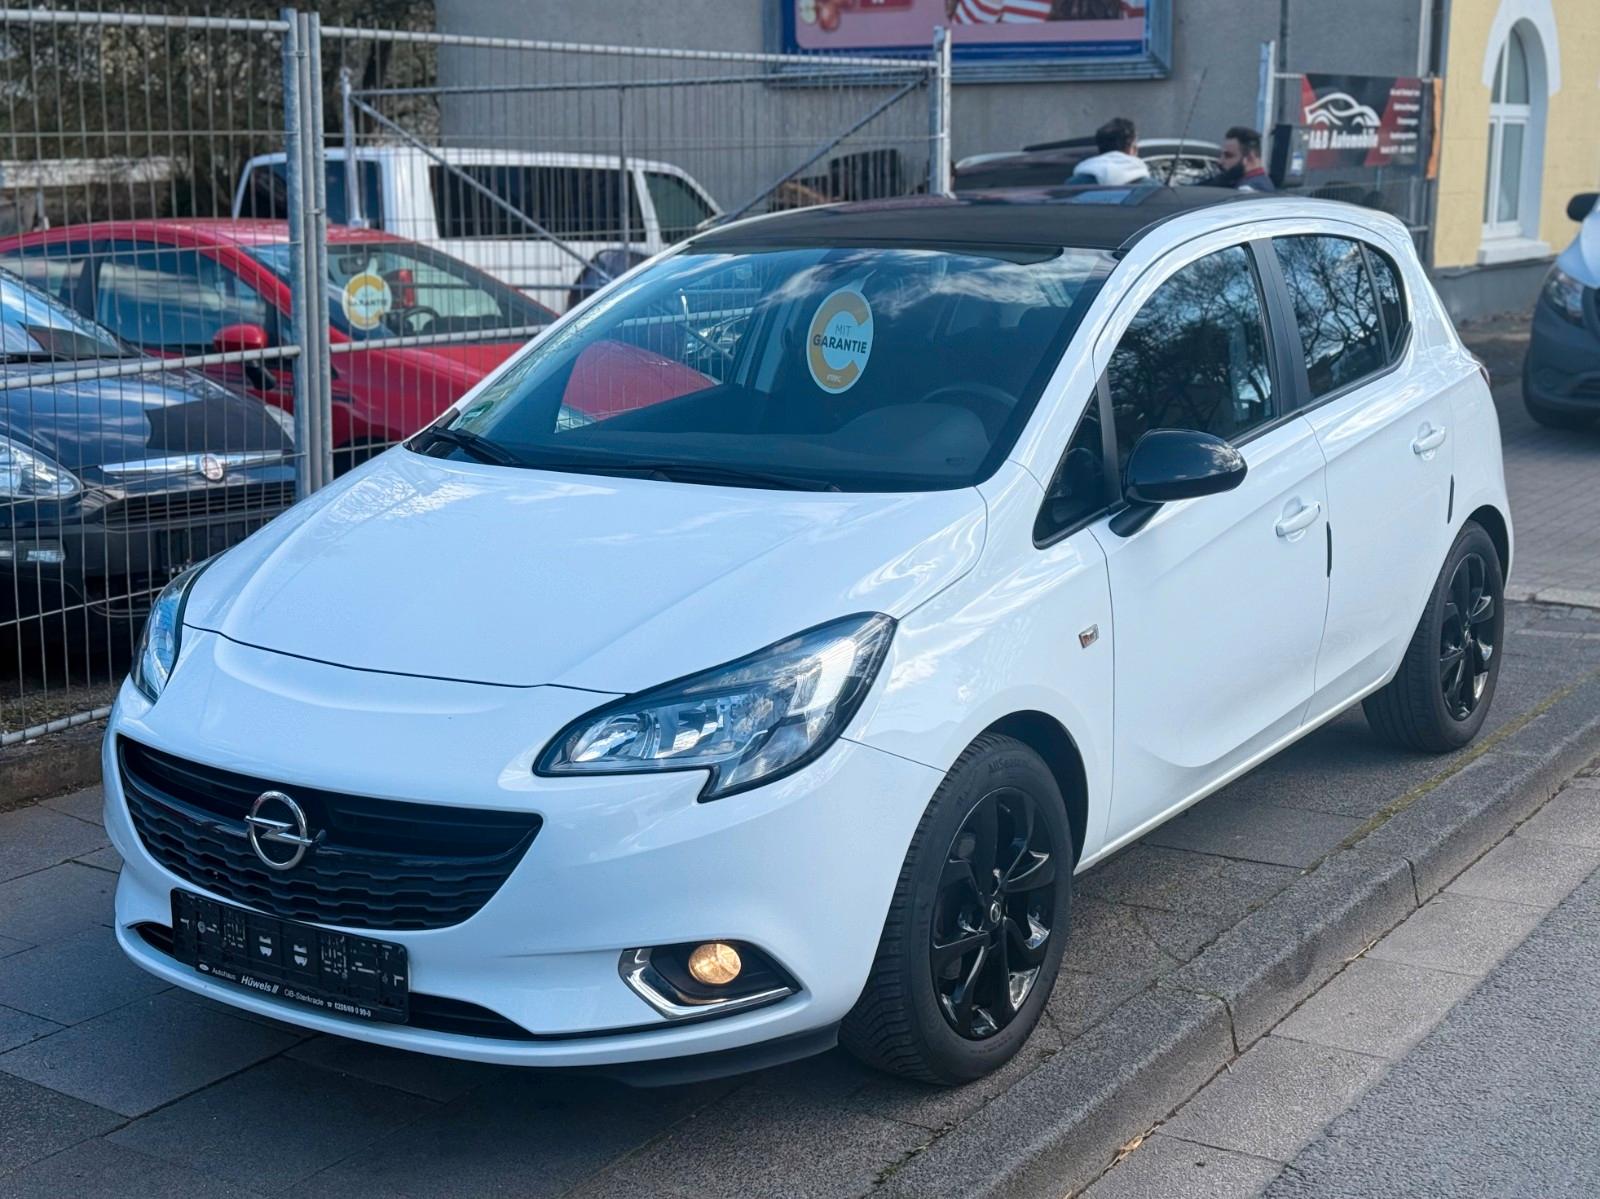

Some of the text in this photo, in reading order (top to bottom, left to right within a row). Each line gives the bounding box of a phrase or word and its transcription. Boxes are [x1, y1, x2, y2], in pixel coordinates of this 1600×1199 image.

[1330, 128, 1379, 149] Automobile
[834, 323, 852, 336] MIT
[813, 334, 868, 354] GARANTIE
[212, 967, 236, 981] Autohaus
